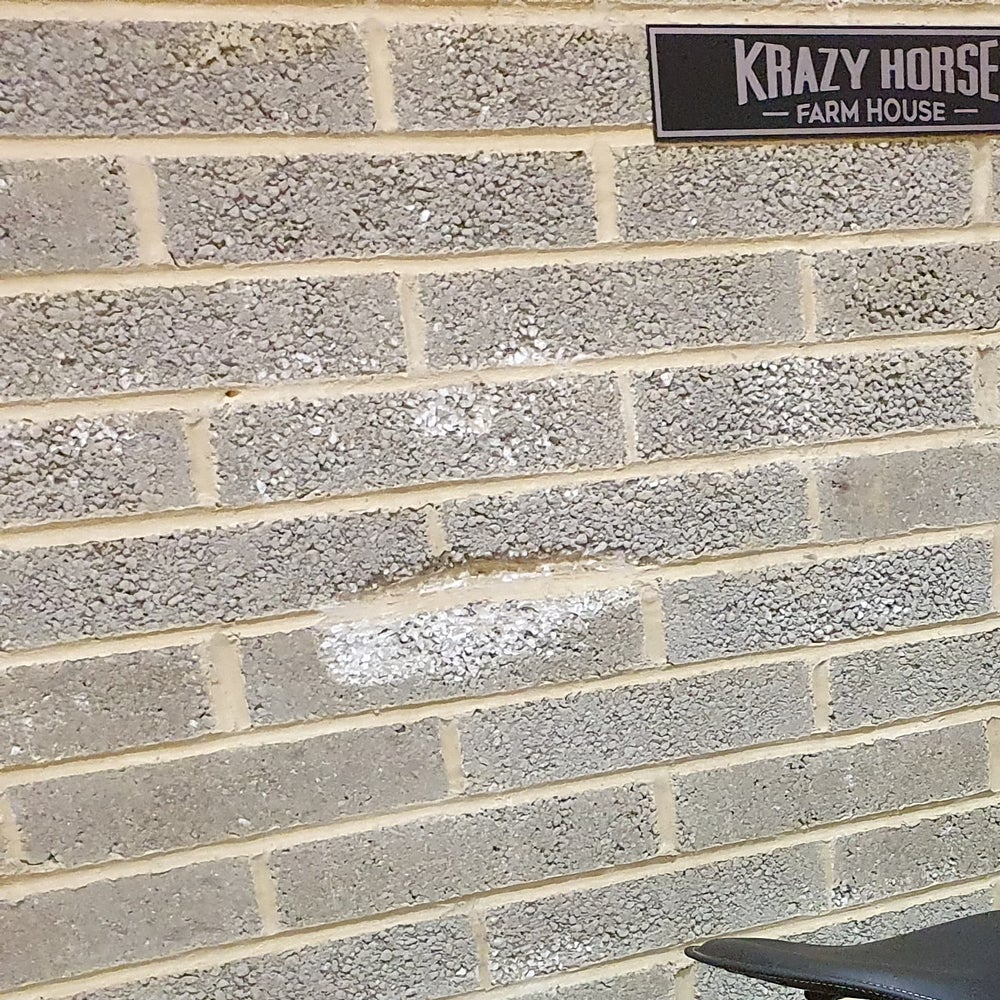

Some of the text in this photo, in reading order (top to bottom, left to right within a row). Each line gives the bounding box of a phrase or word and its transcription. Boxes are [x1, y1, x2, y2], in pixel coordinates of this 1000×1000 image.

[734, 38, 999, 105] KRAZY HORSE
[796, 98, 945, 124] FARM HOUSE
